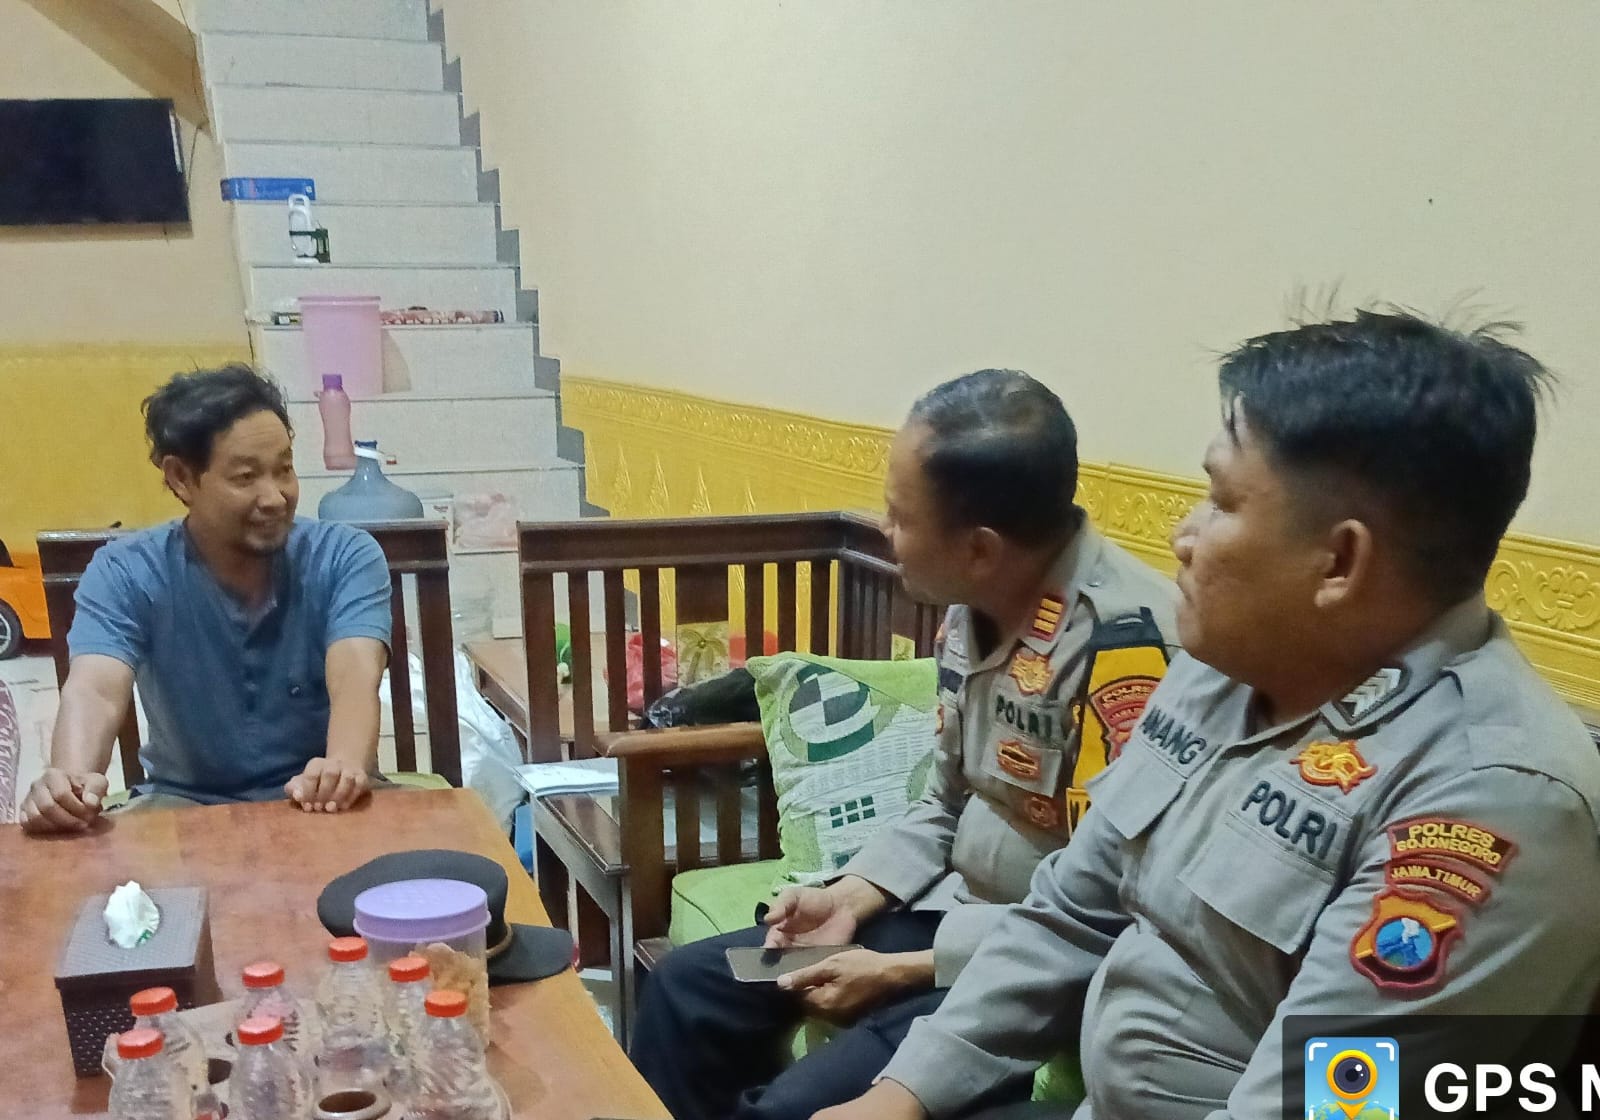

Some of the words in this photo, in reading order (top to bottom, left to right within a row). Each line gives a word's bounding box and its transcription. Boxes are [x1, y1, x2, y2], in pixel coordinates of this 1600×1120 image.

[996, 694, 1053, 736] POLRI
[1241, 780, 1337, 860] POLRI
[1408, 823, 1496, 848] POLRES
[1391, 865, 1432, 879] JAWA
